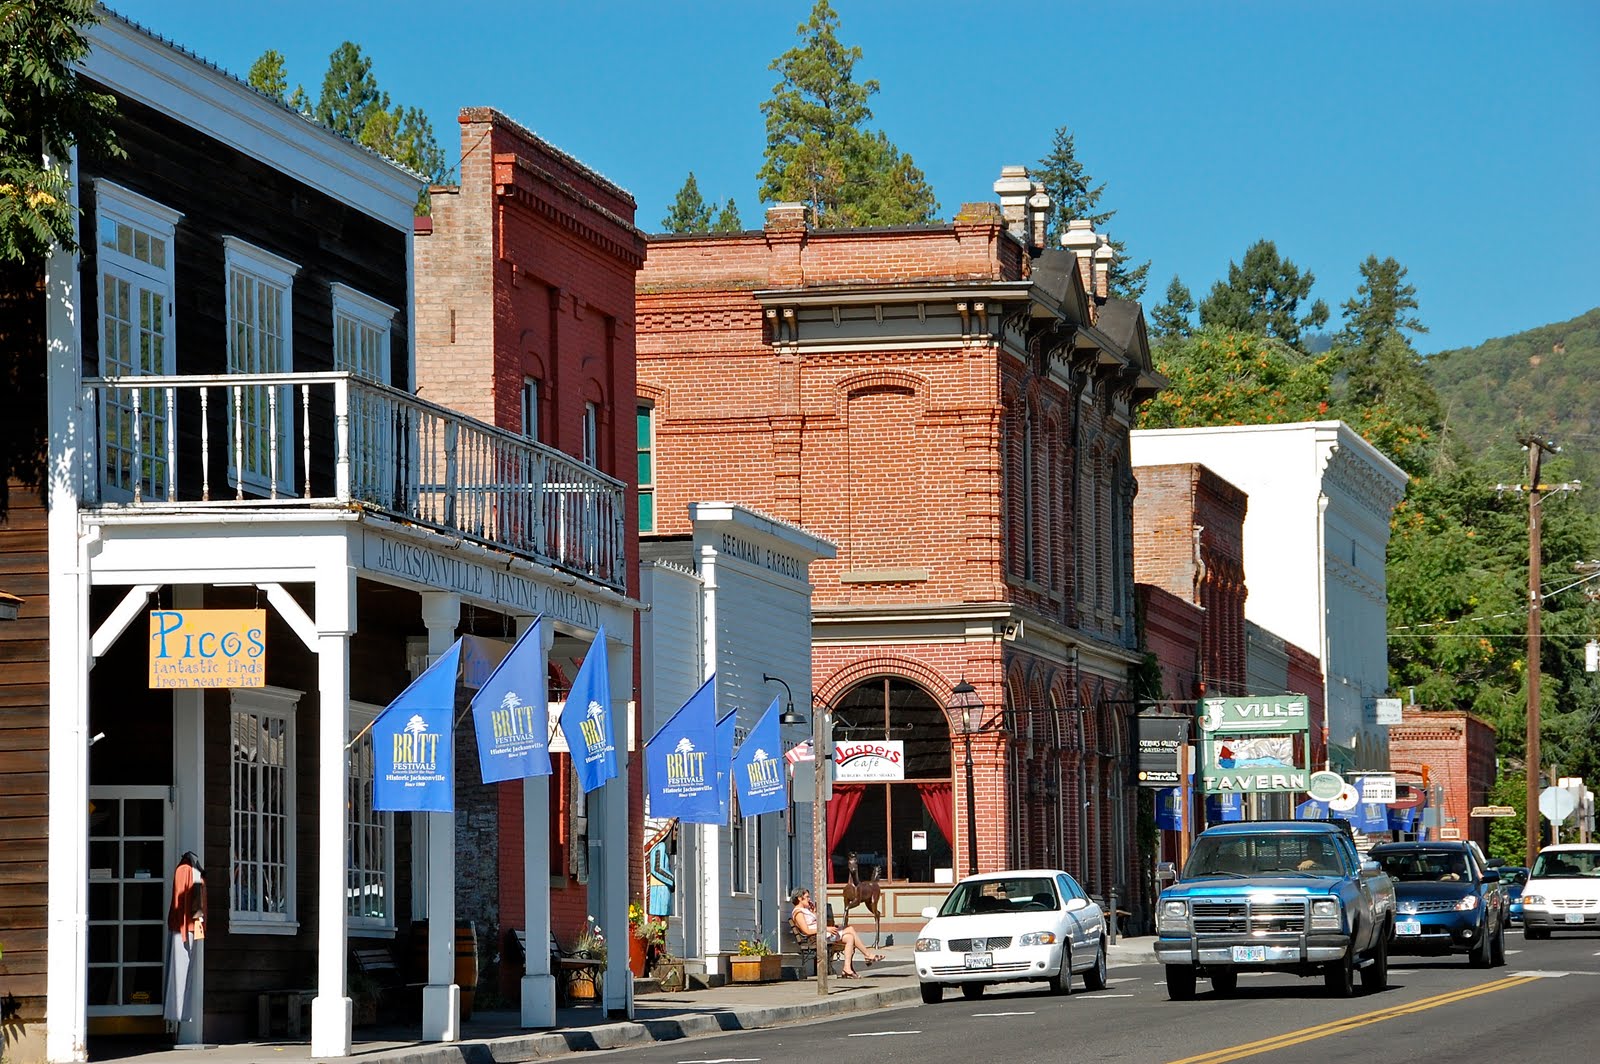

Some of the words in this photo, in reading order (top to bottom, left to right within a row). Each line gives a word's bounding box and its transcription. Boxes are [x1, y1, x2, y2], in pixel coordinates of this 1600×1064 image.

[378, 537, 483, 595] JACKSONVILLE
[490, 571, 537, 610] MINING
[544, 586, 601, 628] COMPANY
[153, 659, 219, 674] fantastic
[227, 659, 263, 674] finds
[155, 674, 189, 688] from
[192, 677, 223, 688] near
[240, 673, 261, 687] far
[1234, 702, 1304, 718] VILLE
[491, 705, 534, 738] BRITT
[495, 732, 534, 745] FESTIVALS
[393, 733, 440, 763] BRITT
[490, 747, 512, 755] Historic
[512, 742, 544, 753] Jacksonville
[835, 744, 901, 765] Jaspers
[666, 751, 706, 779] BRITT
[747, 758, 778, 783] BRITT
[409, 774, 445, 782] Jacksonville
[668, 776, 704, 785] FESTIVALS
[1203, 773, 1304, 790] TAVERN
